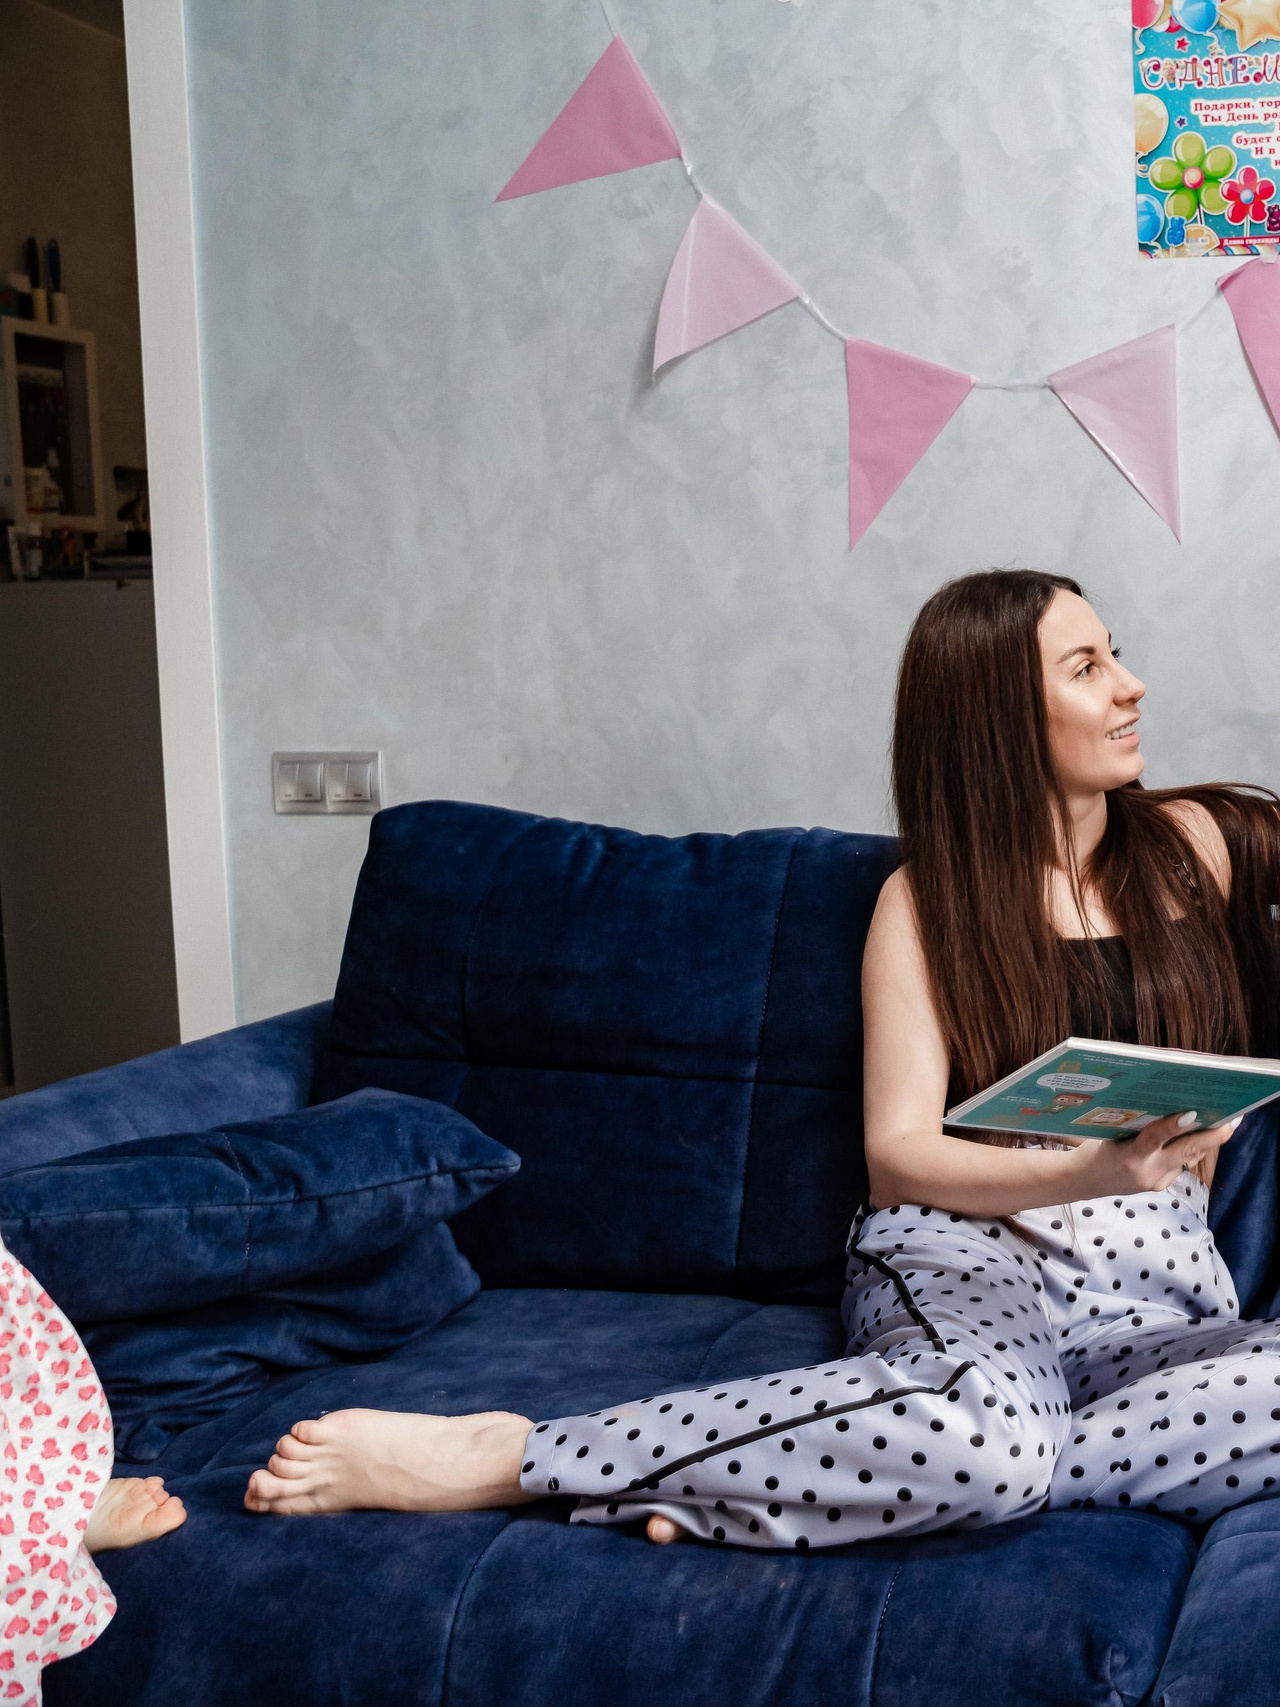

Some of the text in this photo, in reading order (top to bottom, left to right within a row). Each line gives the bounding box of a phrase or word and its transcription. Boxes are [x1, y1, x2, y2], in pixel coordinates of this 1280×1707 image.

[1194, 101, 1255, 111] Подарки,
[1203, 114, 1222, 123] Ты
[1226, 112, 1259, 123] День
[1235, 135, 1272, 146] будет
